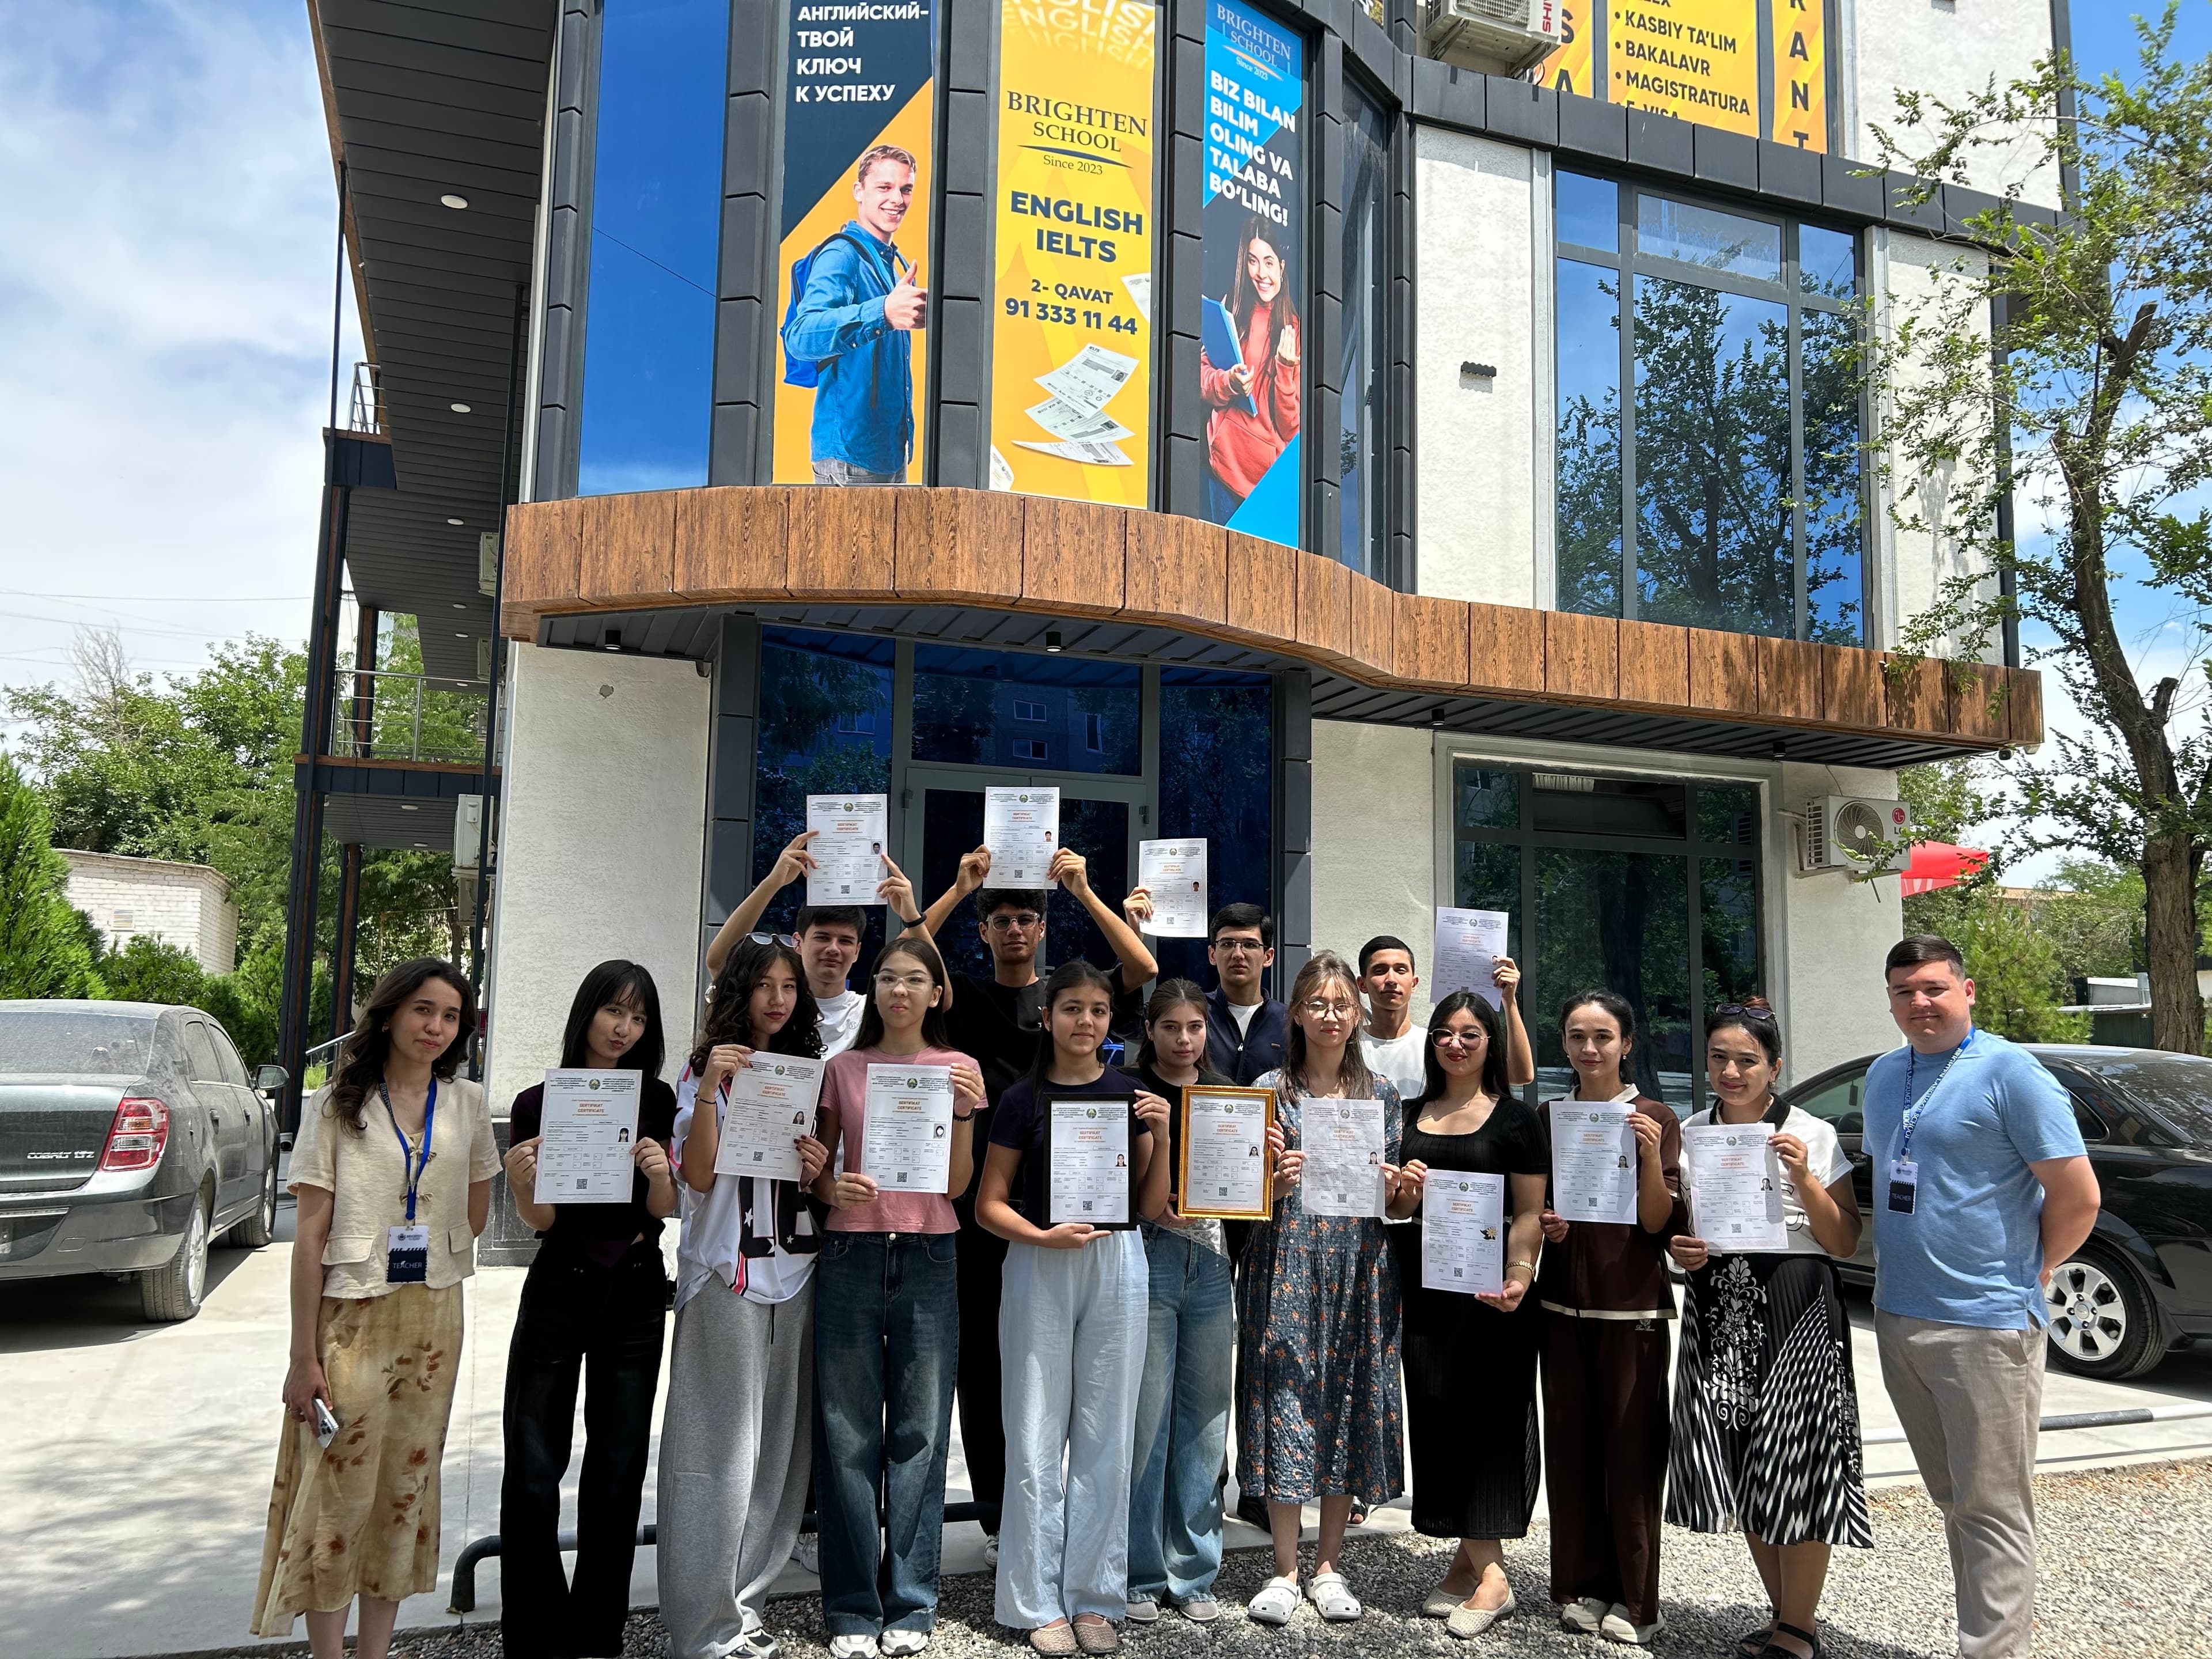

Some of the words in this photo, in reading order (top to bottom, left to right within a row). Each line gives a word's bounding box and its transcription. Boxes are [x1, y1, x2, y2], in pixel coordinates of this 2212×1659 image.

[797, 1, 929, 21] АНГЛИЙСКИЙ-
[1542, 0, 1552, 33] SHI
[797, 26, 854, 47] ТВОЙ
[1217, 3, 1291, 60] BRIGHTEN
[1230, 31, 1277, 67] SCHOOL
[1626, 10, 1683, 39] KASBIY
[1687, 26, 1736, 54] TA'LIM
[797, 58, 861, 75] КЛЮЧ
[1236, 56, 1253, 72] Since
[1253, 67, 1268, 81] 2023
[1626, 40, 1710, 77] BAKALAVR
[796, 86, 810, 102] К
[815, 85, 896, 102] УСПЕХУ
[1211, 70, 1240, 102] BIZ
[1244, 88, 1296, 133] BILAN
[1626, 70, 1751, 116] MAGISTRATURA
[1007, 90, 1147, 137] BRIGHTEN
[1210, 95, 1258, 137] BILIM
[1033, 122, 1121, 153] SCHOOL
[1210, 122, 1266, 165] OLING
[1269, 151, 1293, 181] VA
[1043, 154, 1074, 169] Since
[1077, 161, 1103, 175] 2023
[1210, 146, 1281, 199] TALABA
[1011, 191, 1143, 235] ENGLISH
[1037, 228, 1117, 263] IELTS
[1031, 279, 1050, 292] 2-
[1054, 283, 1113, 304] QAVAT
[1005, 298, 1029, 317] 91
[1036, 302, 1077, 325] 333
[1083, 310, 1101, 329] 11
[1108, 315, 1138, 335] 44
[1892, 1193, 1912, 1202] TEACHER
[393, 1261, 422, 1269] TEACHER
